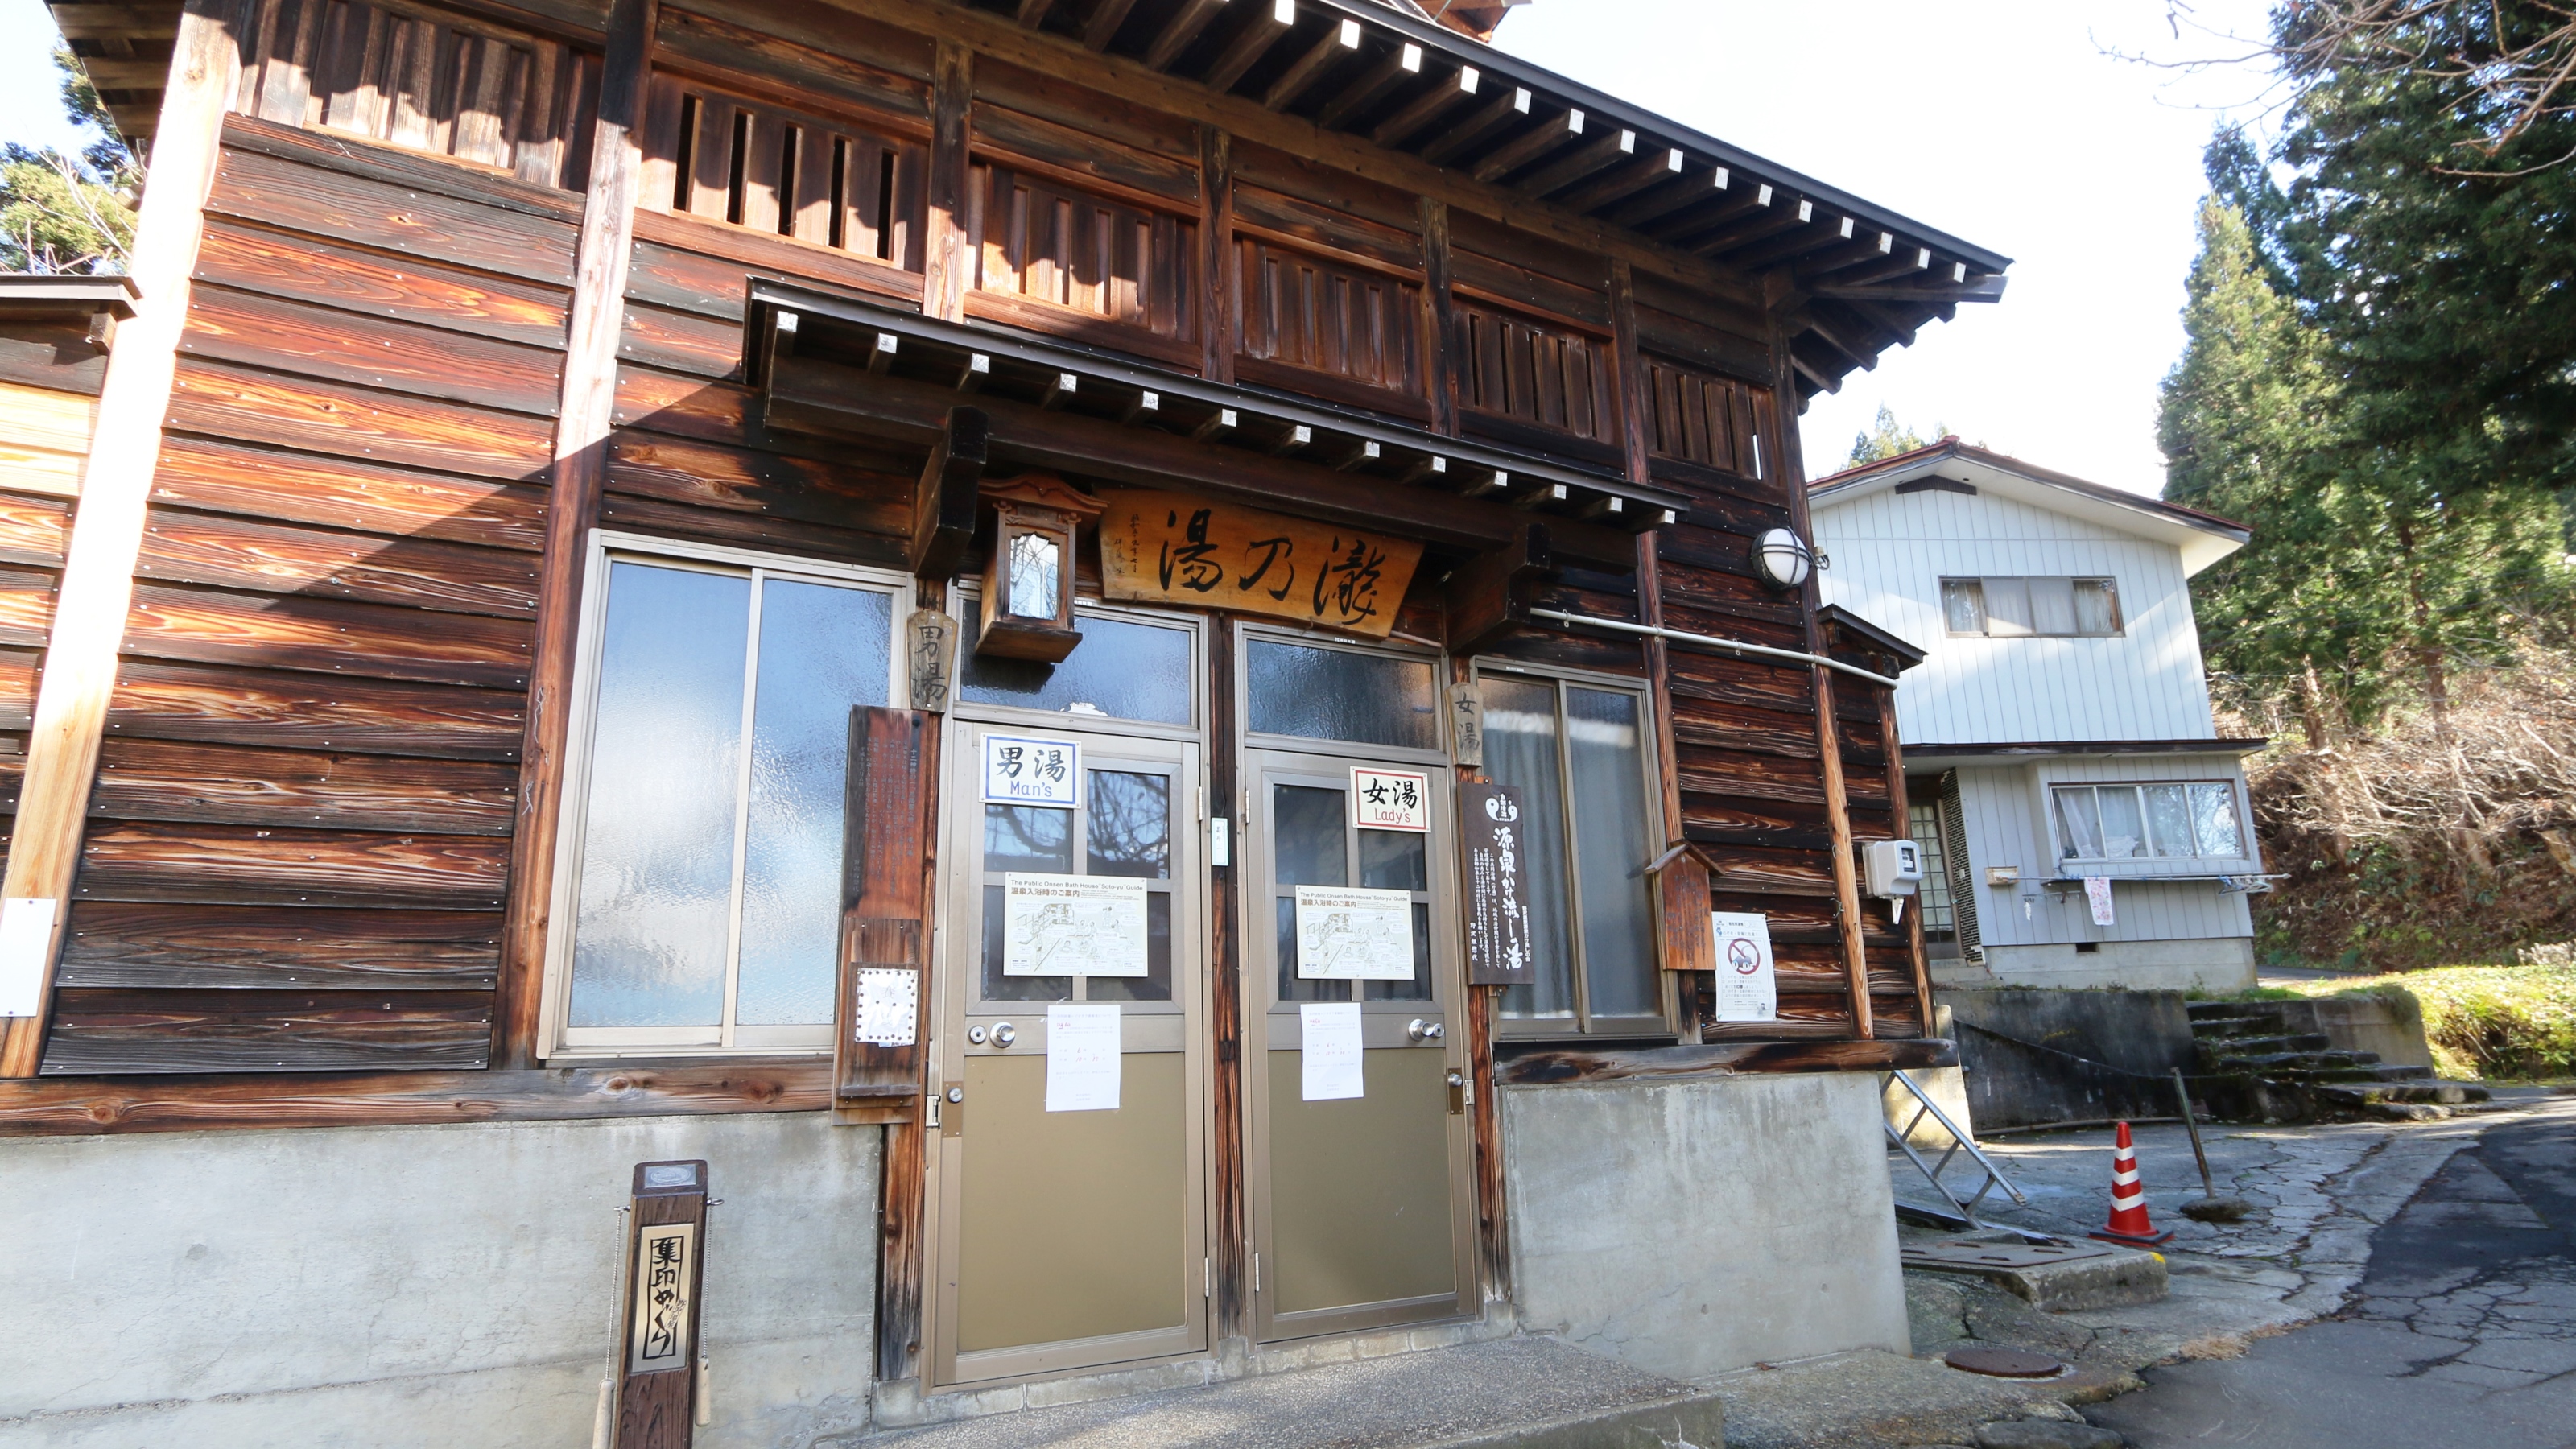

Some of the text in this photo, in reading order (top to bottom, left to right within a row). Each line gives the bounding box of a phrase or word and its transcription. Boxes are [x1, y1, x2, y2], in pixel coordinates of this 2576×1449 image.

[911, 625, 947, 701] 男湯
[1454, 691, 1480, 751] 女湯
[996, 746, 1067, 782] 男湯
[1009, 780, 1053, 797] Man's
[1361, 778, 1418, 810] 女湯
[1374, 807, 1411, 824] Lady's
[1011, 887, 1080, 898] 温泉入浴時のご案内
[1300, 898, 1356, 908] 温泉入浴時のご案内
[1492, 826, 1523, 971] 源泉かけ流しの湯
[651, 1238, 681, 1356] 集印めぐり
[667, 1299, 687, 1328] 野沢温泉
